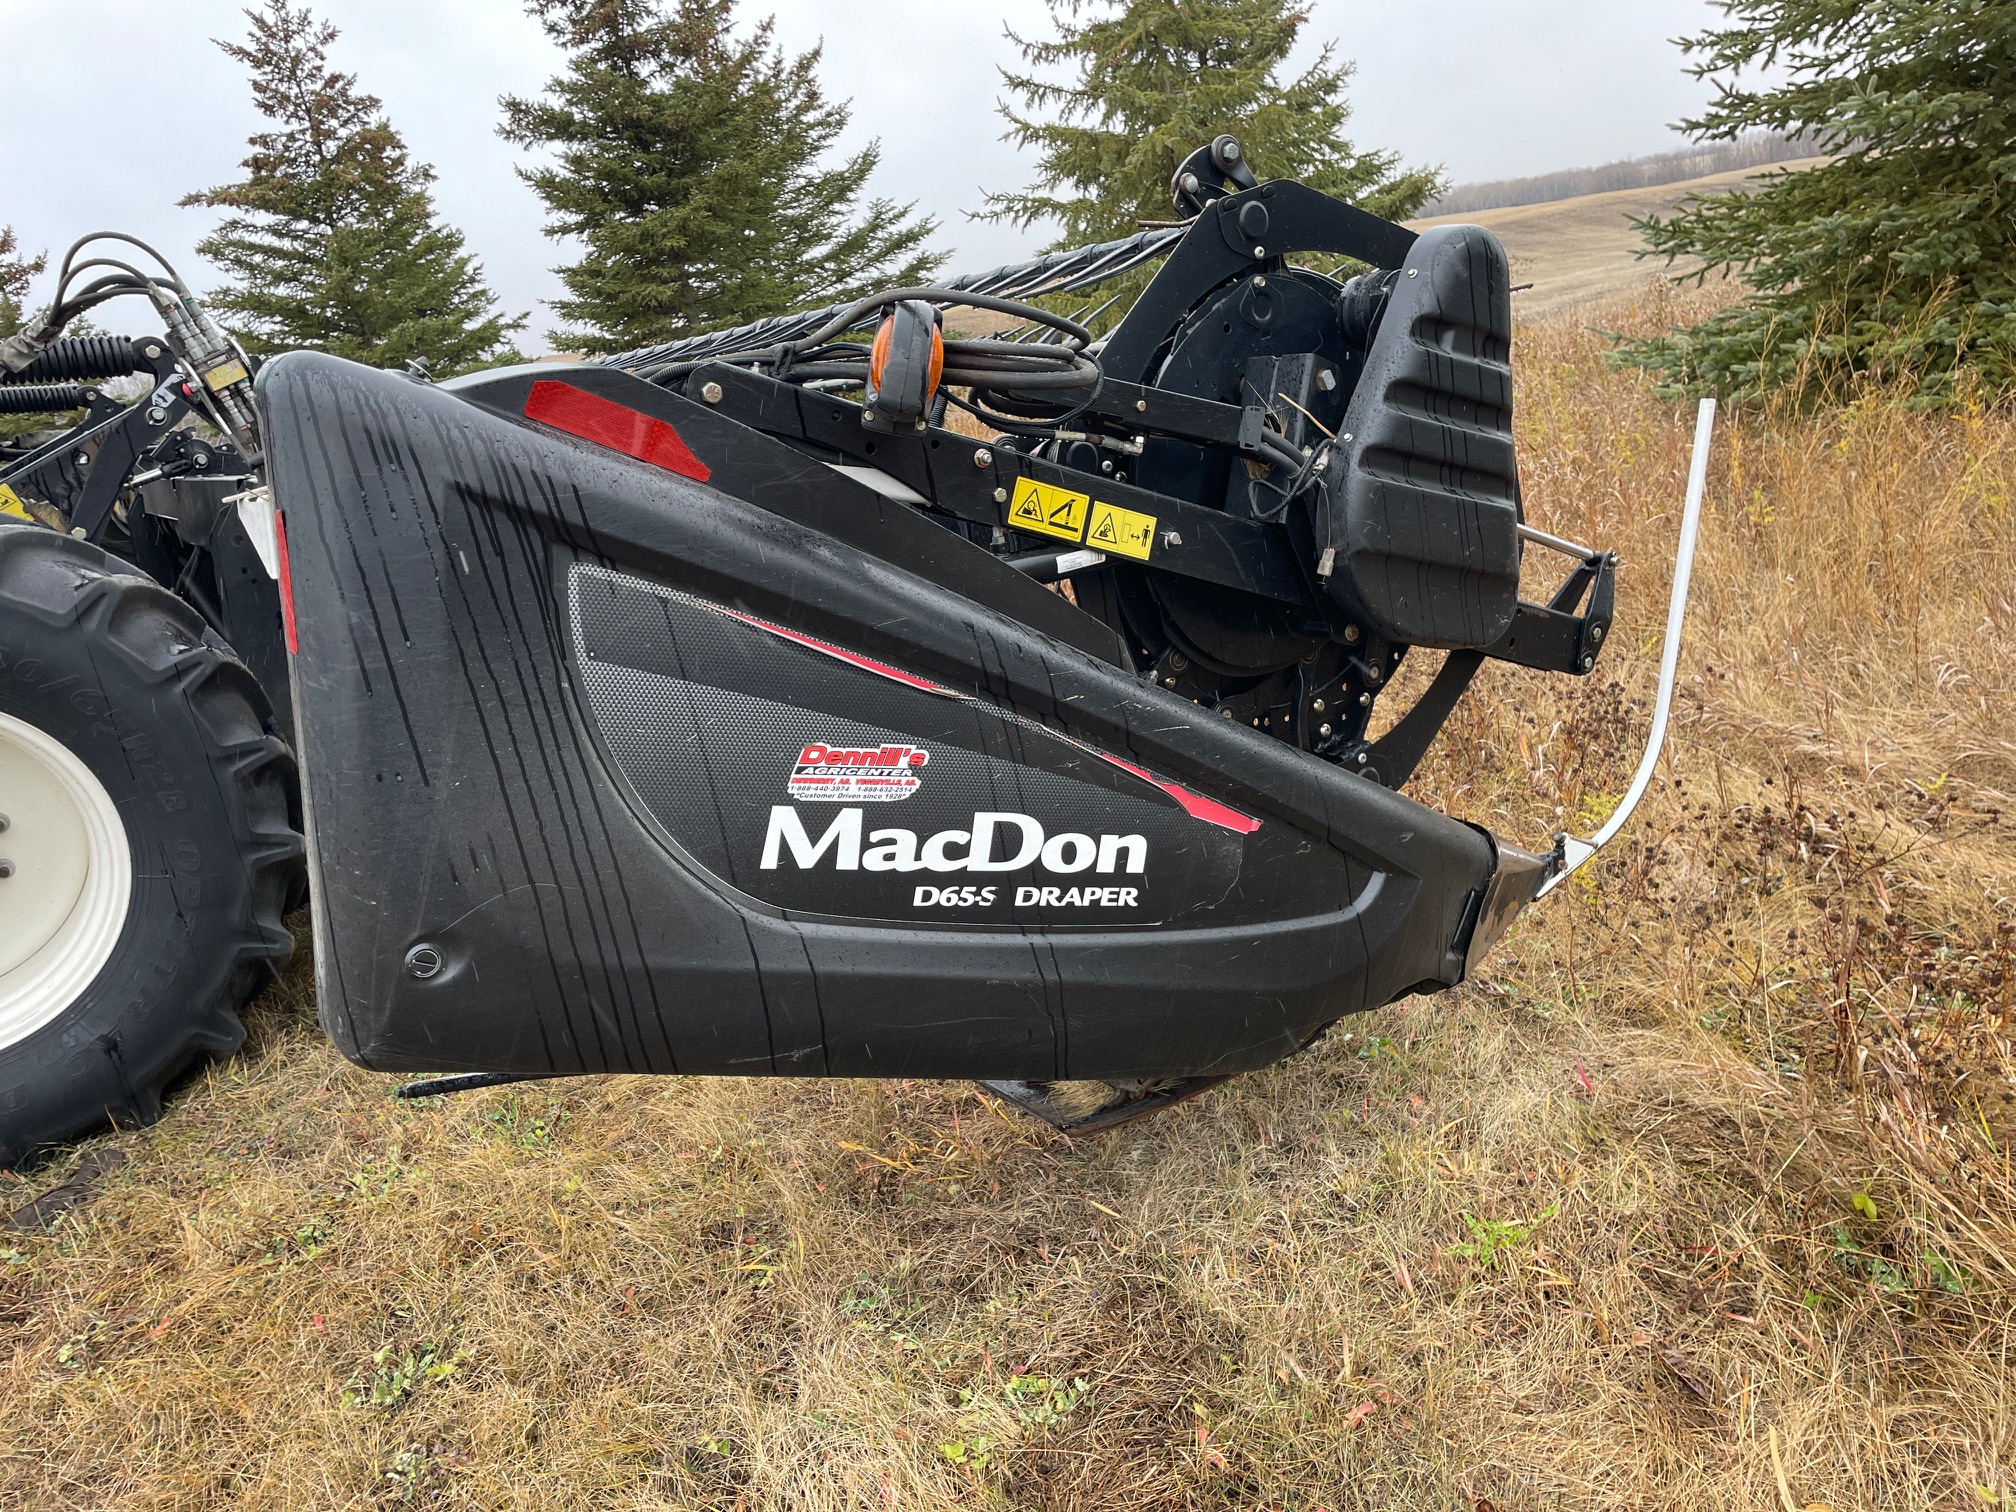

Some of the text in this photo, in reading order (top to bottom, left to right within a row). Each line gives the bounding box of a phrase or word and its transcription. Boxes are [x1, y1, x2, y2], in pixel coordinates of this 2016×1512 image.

[798, 745, 926, 767] Dennill's
[800, 766, 913, 777] AGRICENTER
[759, 804, 1148, 874] MacDon
[912, 886, 1139, 907] D65-S DRAPER
